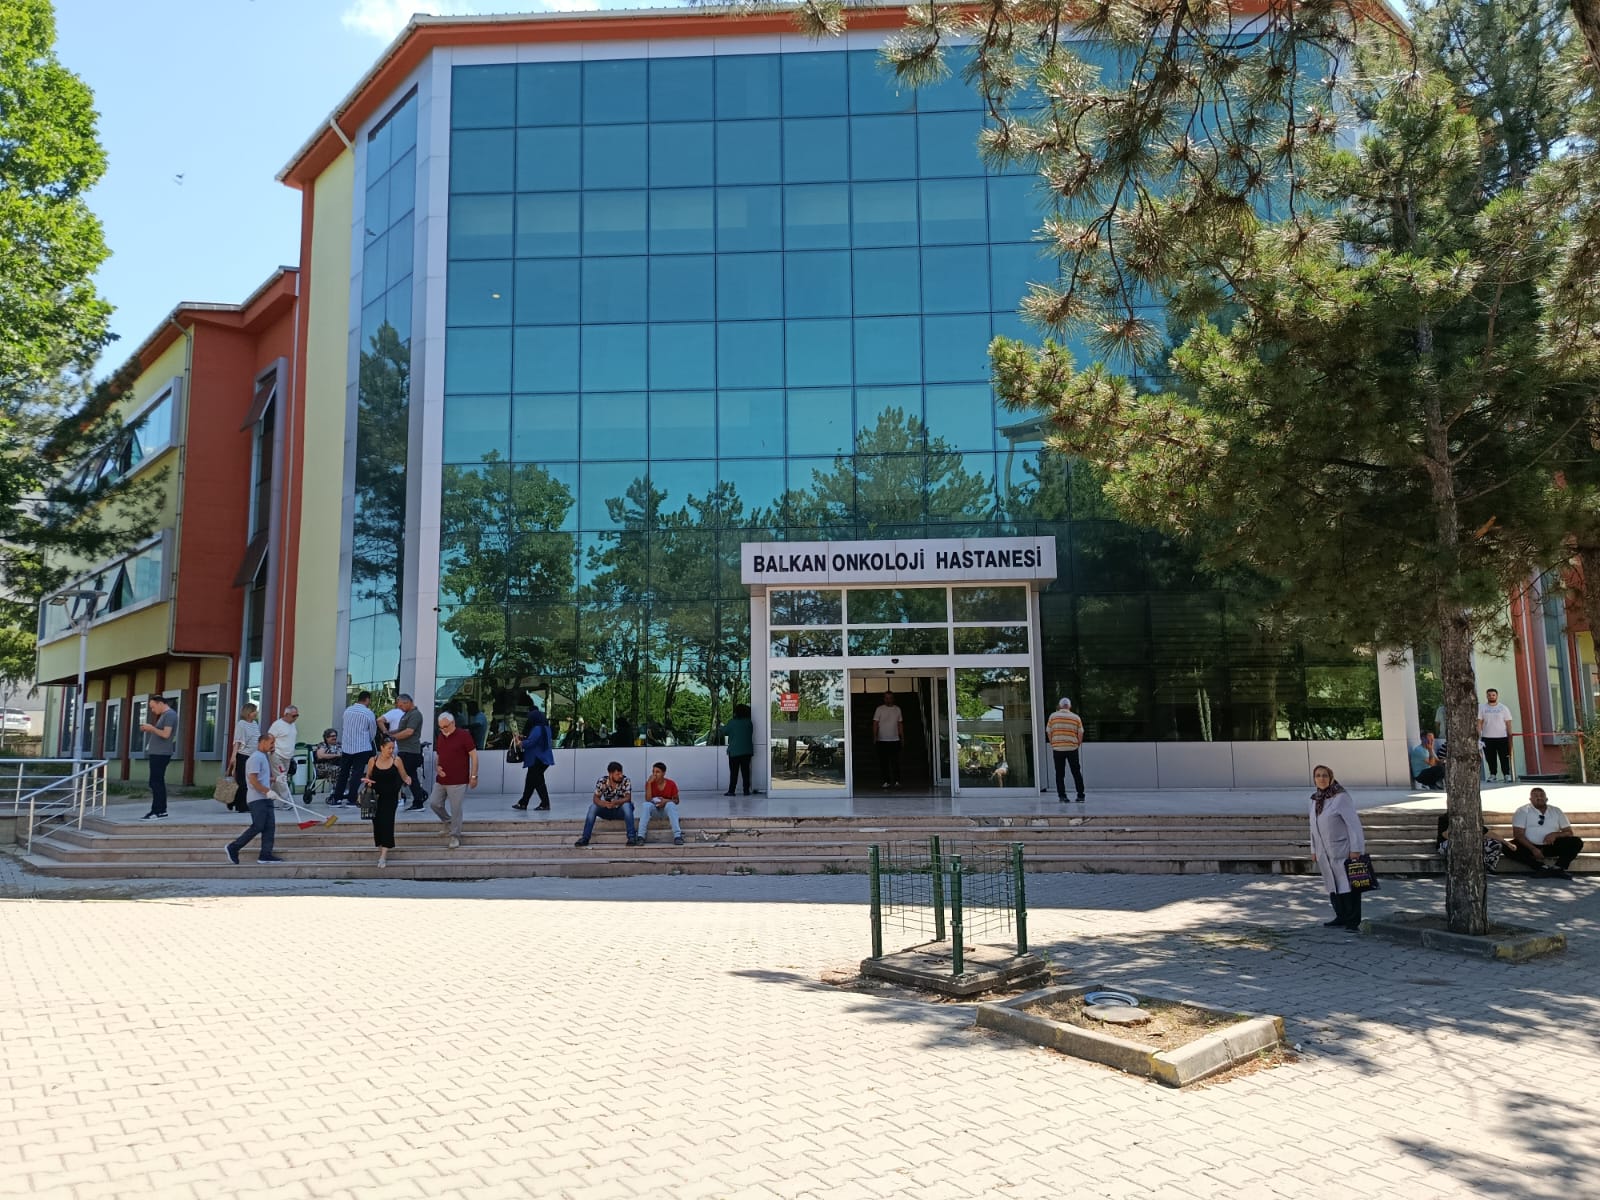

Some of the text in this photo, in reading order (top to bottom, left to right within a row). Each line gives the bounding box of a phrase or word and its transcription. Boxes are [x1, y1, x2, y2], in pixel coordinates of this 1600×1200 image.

[754, 546, 1041, 573] BALKAN ONKOLOJİ HASTANESİ
